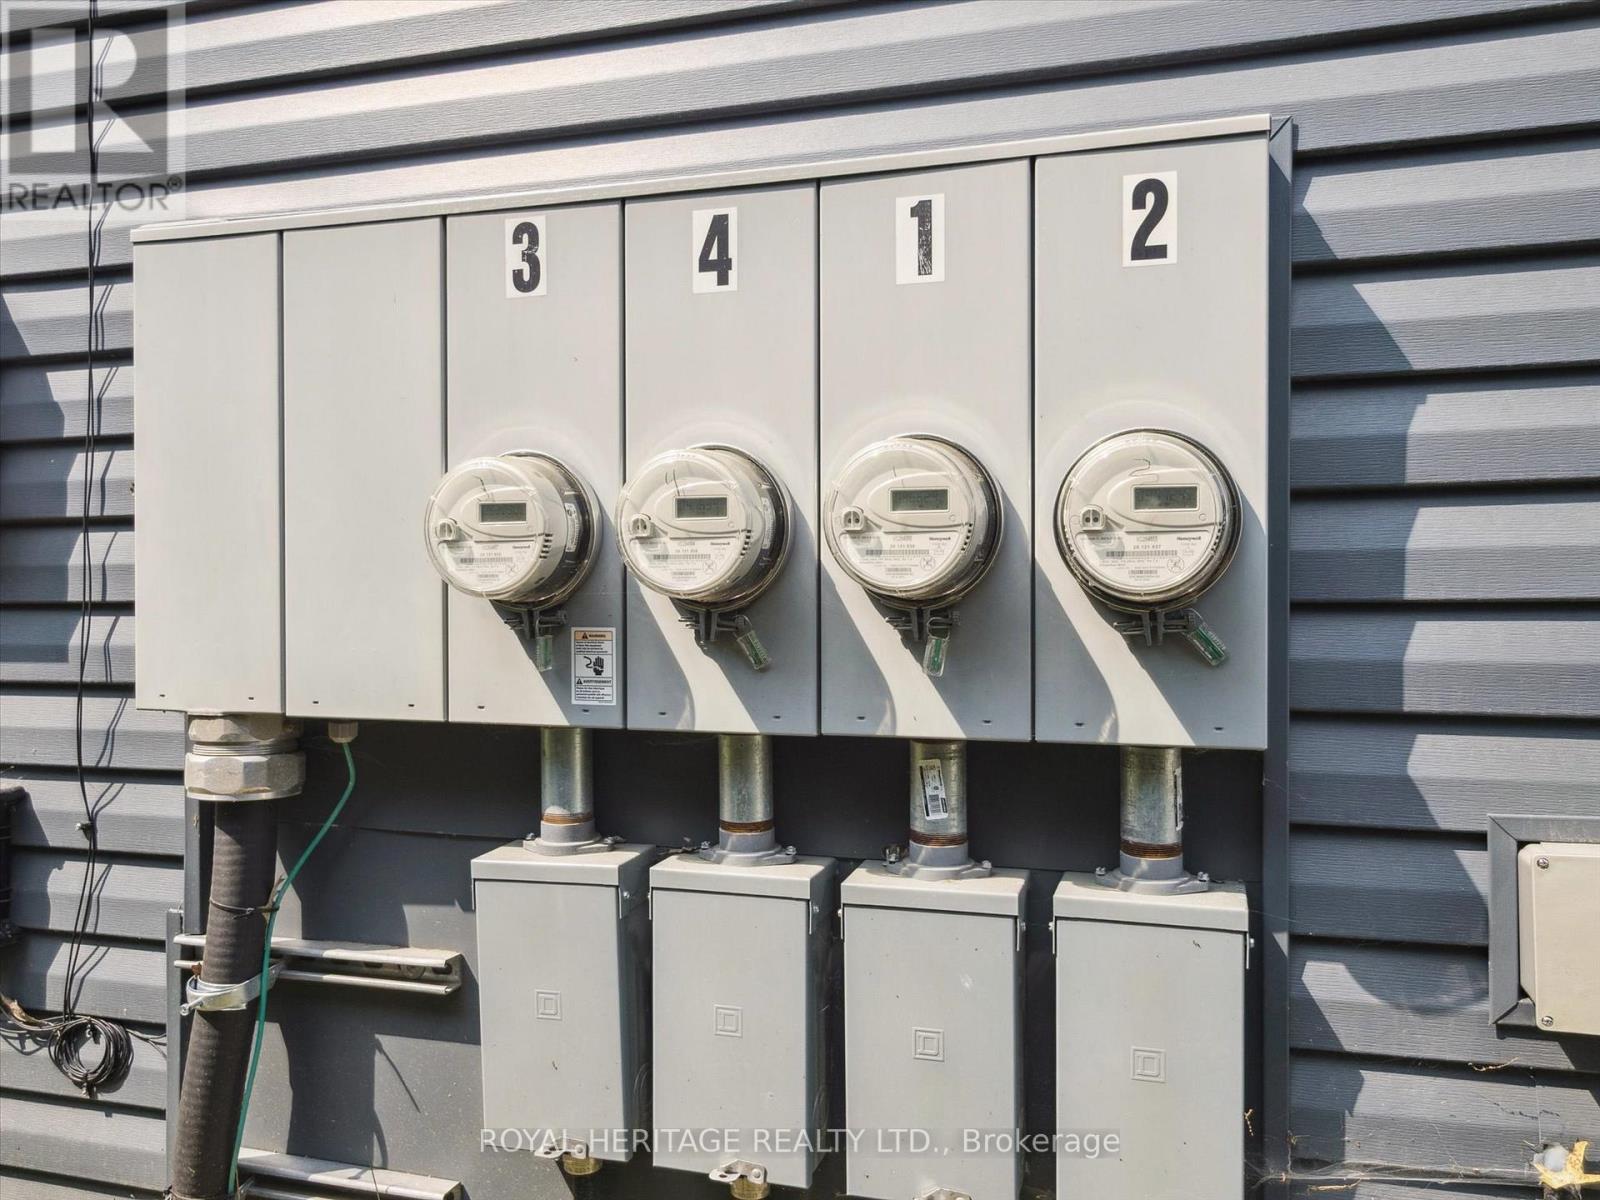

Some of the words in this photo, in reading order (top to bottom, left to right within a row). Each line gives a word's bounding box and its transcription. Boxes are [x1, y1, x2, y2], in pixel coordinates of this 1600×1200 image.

[698, 213, 733, 287] 4
[910, 199, 933, 276] 1
[1131, 177, 1169, 261] 2
[512, 221, 541, 293] 3
